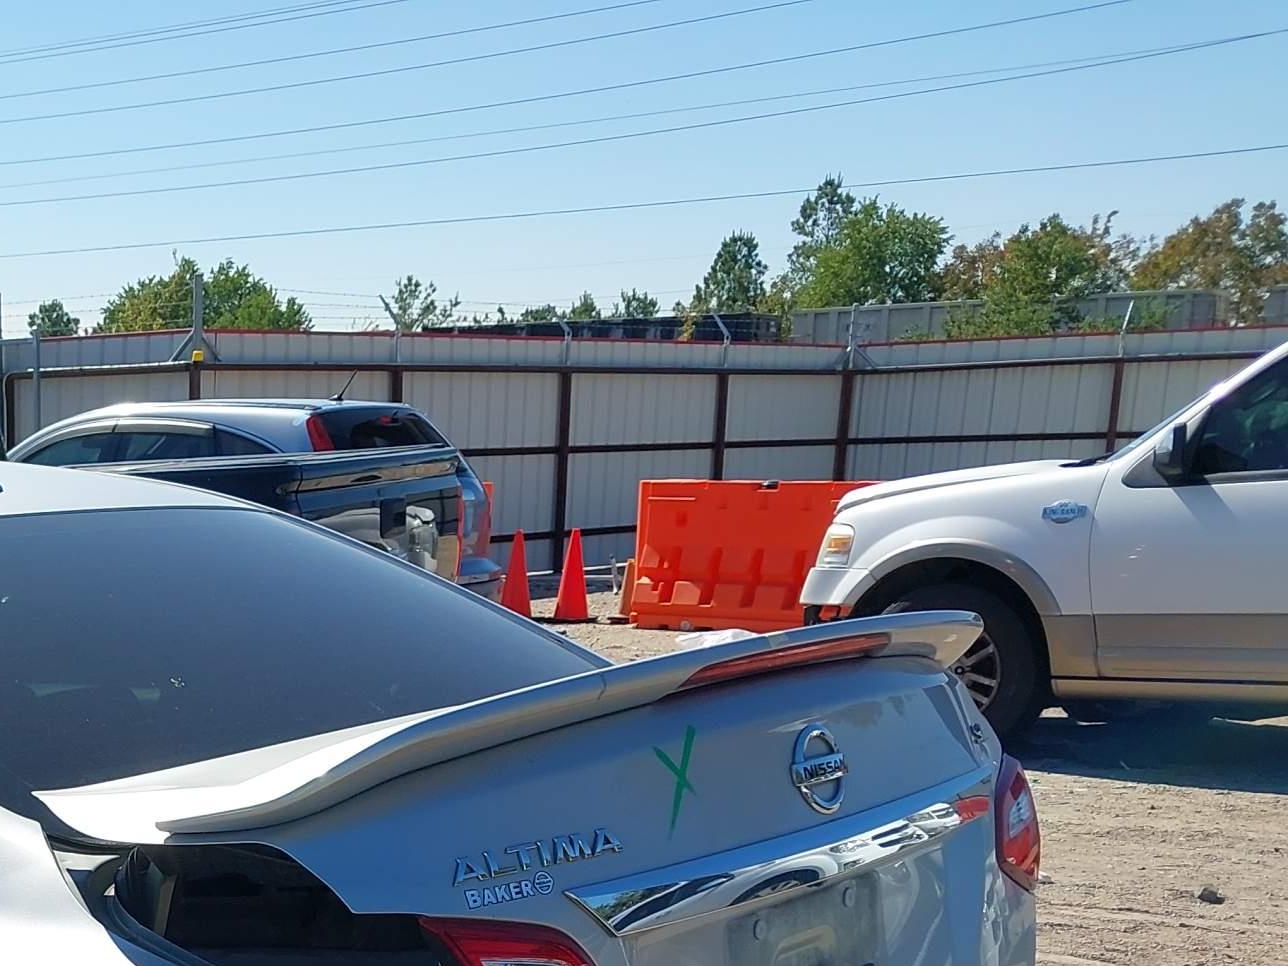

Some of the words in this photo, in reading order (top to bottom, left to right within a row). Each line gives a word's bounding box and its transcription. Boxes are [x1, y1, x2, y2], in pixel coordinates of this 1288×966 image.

[802, 757, 848, 780] NISSAN
[452, 827, 624, 887] ALTIMA
[464, 879, 538, 910] BAKER
